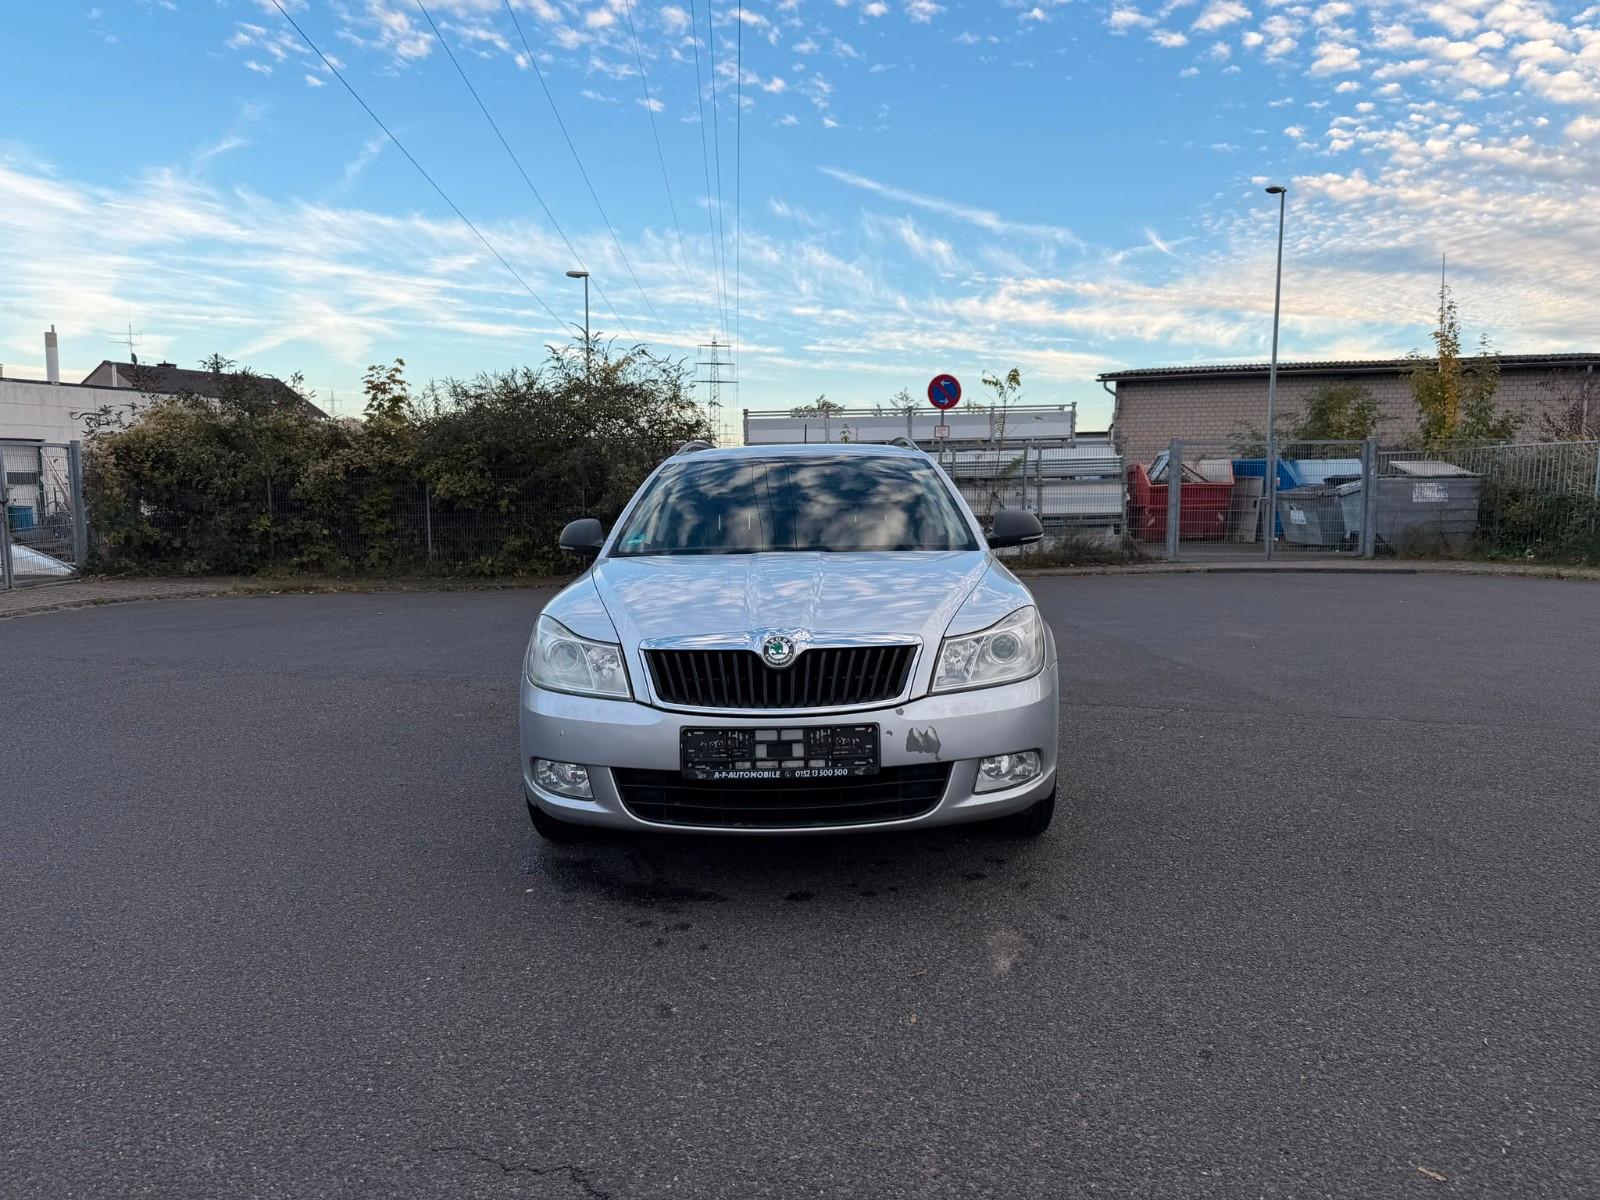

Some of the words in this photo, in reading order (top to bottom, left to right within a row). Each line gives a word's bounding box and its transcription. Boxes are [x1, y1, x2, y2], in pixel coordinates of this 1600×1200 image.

[713, 770, 781, 779] A-F-AUTOMOBILE
[795, 770, 811, 778] 0152
[811, 769, 819, 777] 13
[819, 769, 833, 777] 500
[834, 768, 848, 776] 500
